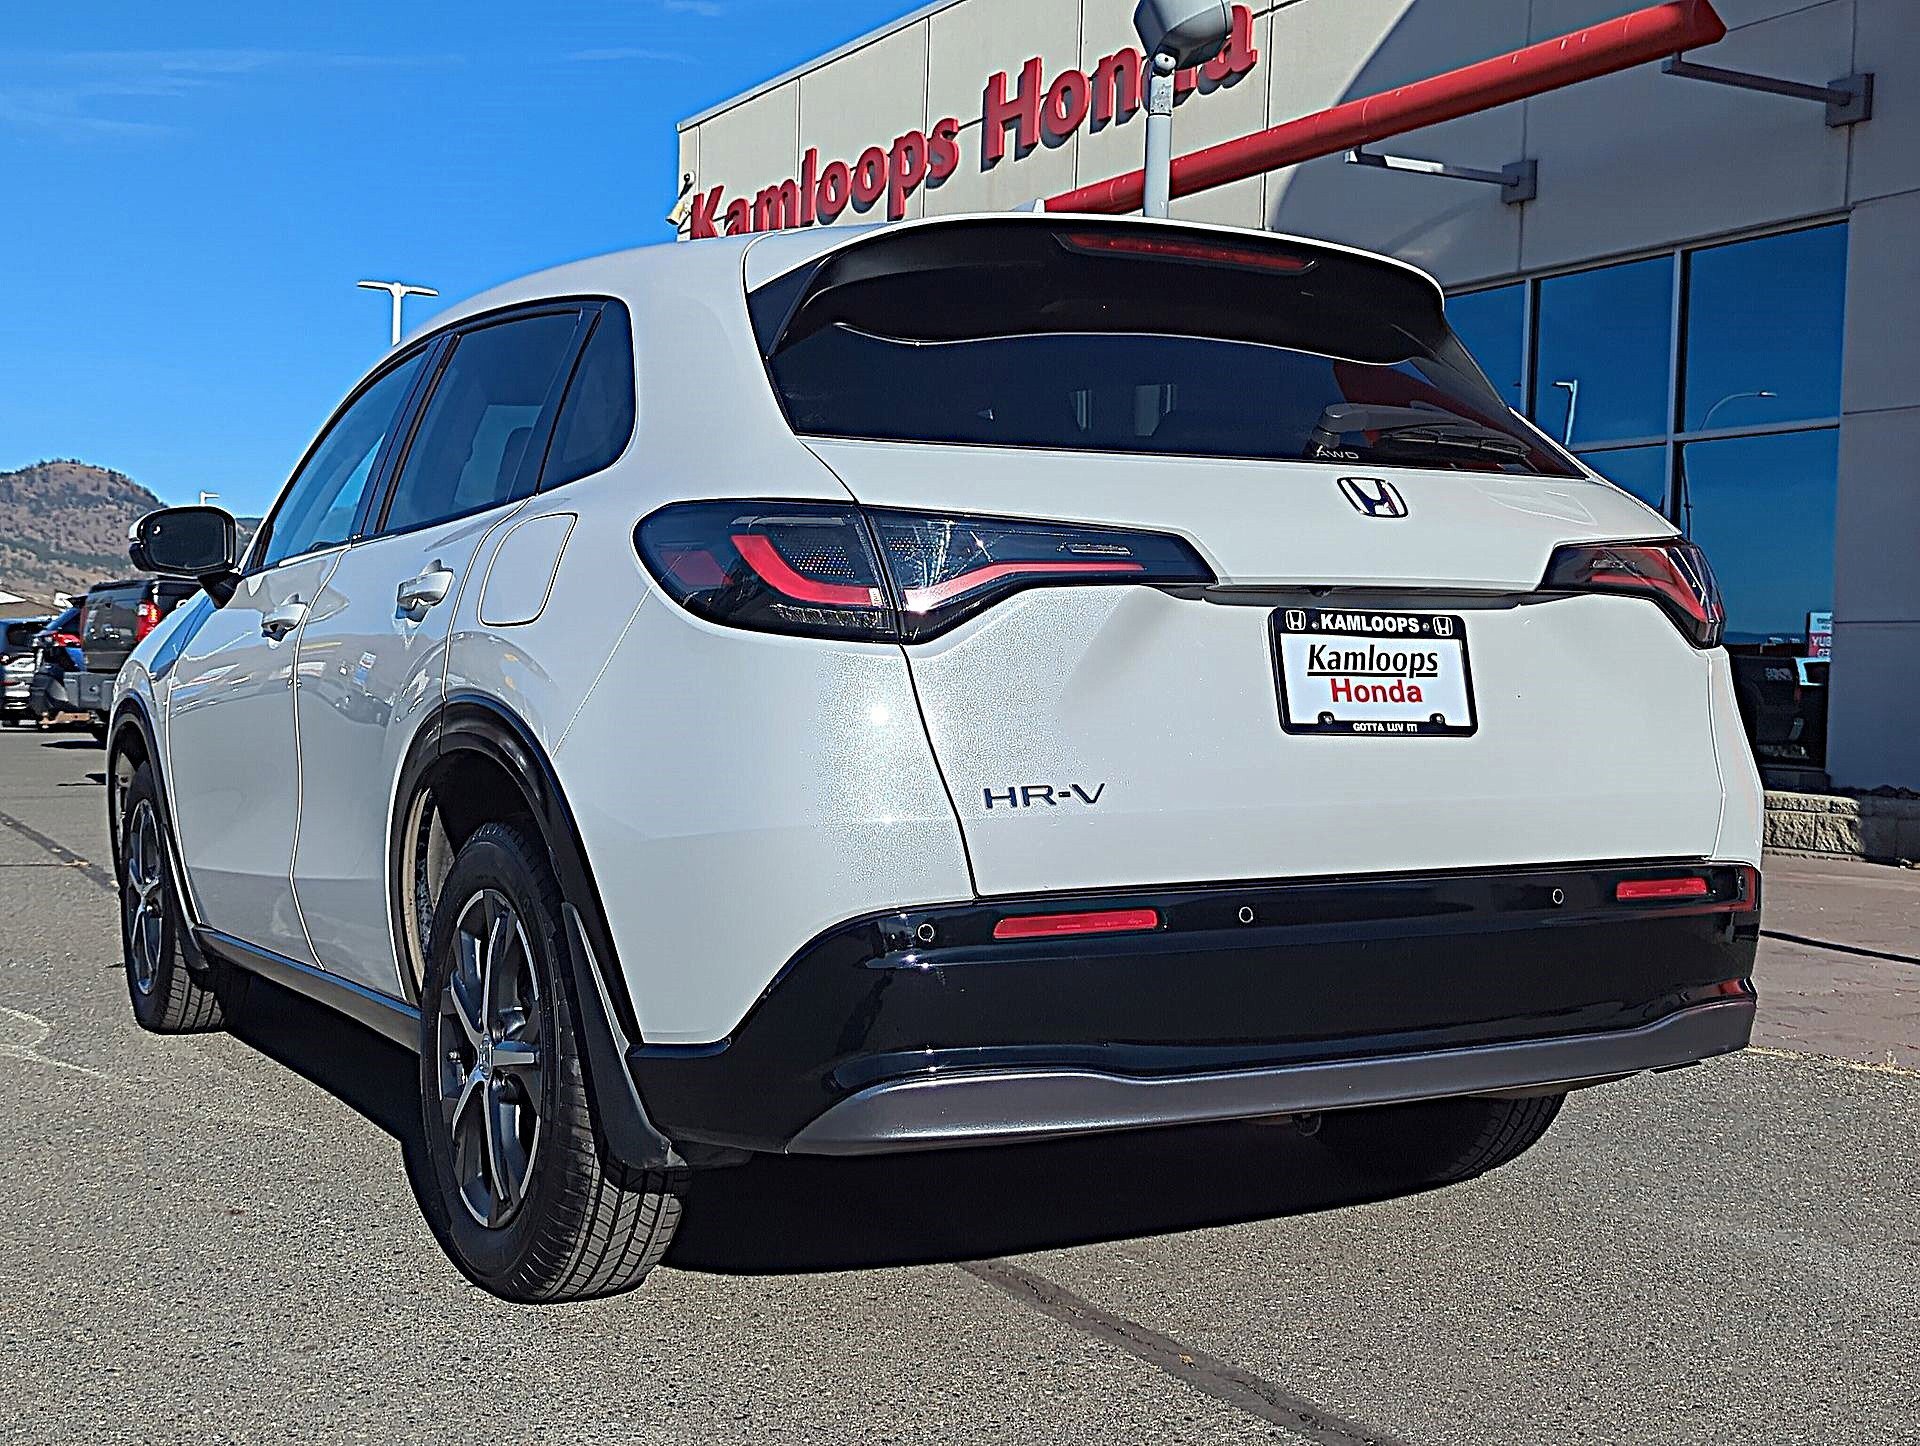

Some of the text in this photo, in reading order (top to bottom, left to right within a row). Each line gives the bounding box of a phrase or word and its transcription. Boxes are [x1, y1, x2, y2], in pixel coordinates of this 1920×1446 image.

[691, 117, 960, 239] Kamloops
[1316, 445, 1359, 459] AWD
[1320, 613, 1420, 633] KAMLOOPS
[1307, 643, 1438, 679] Kamloops
[1330, 678, 1423, 703] Honda
[1352, 722, 1385, 732] GOTTA
[1386, 722, 1404, 732] LUV
[983, 782, 1105, 809] HR-V
